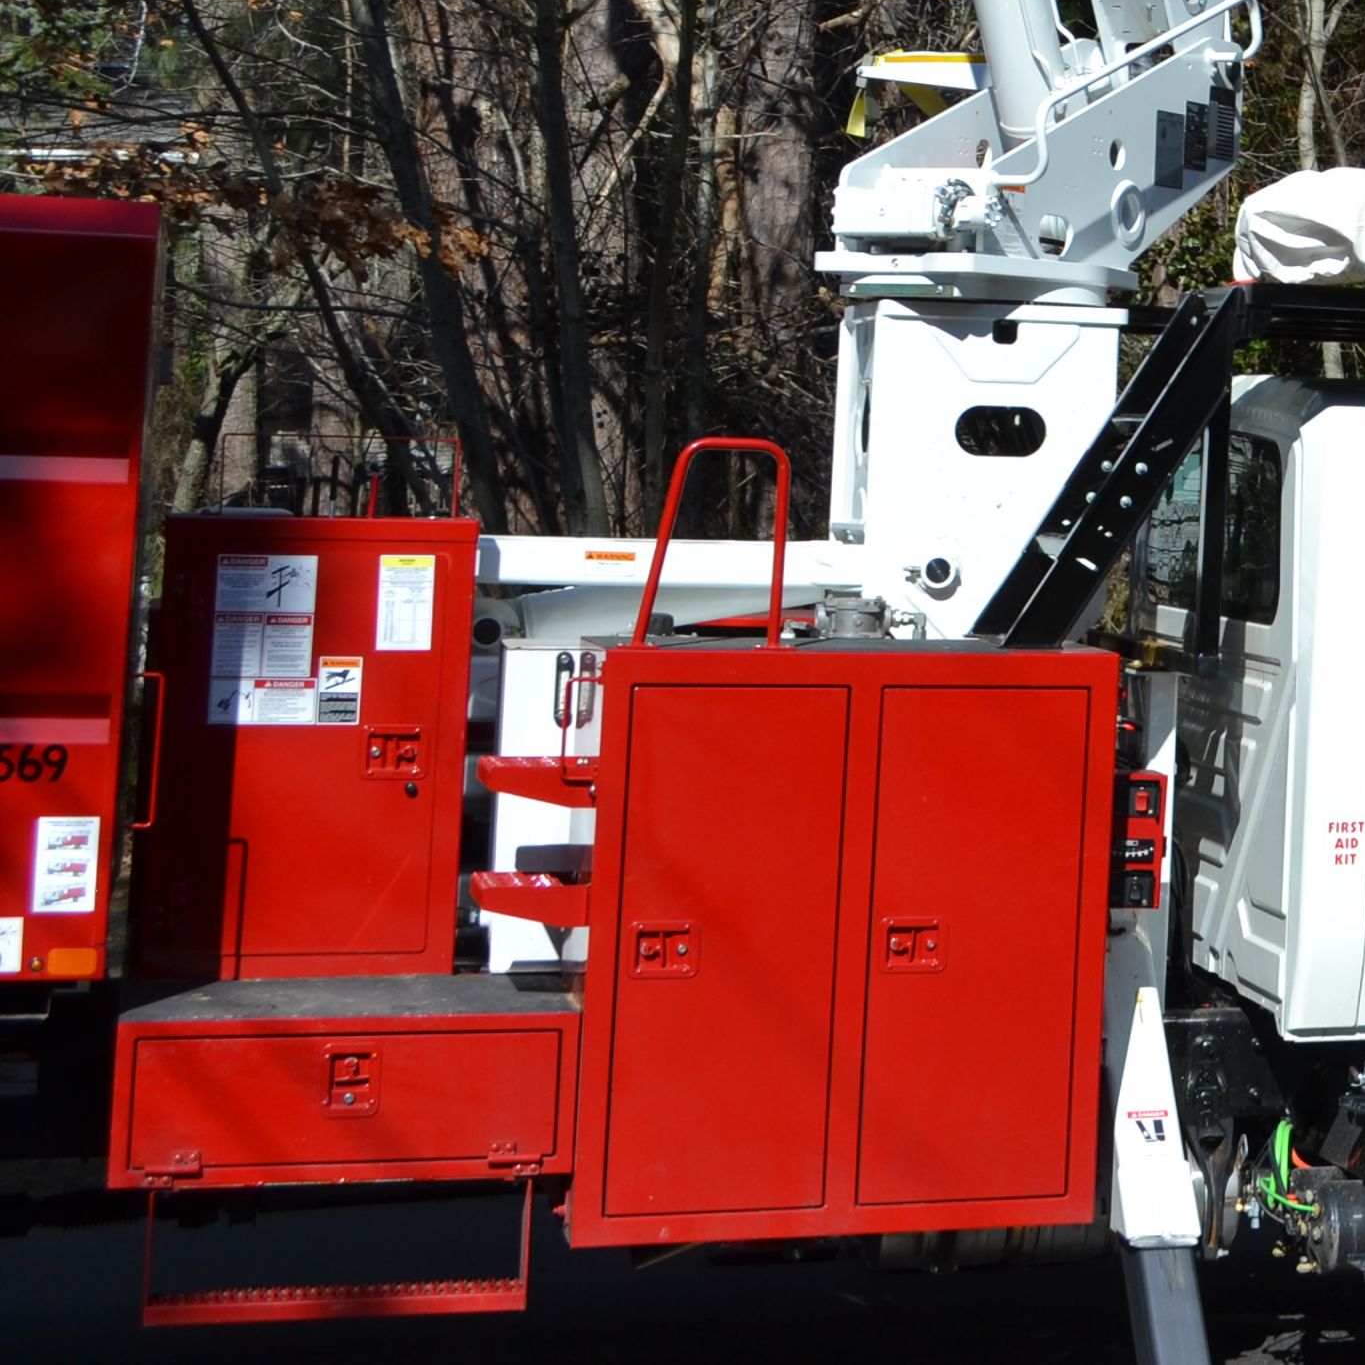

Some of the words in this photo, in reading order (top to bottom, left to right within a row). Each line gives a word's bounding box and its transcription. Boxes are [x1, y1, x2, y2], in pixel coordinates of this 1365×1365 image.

[229, 557, 266, 565] DANGER
[226, 615, 260, 623] DANGER
[277, 616, 308, 624] DANGER
[1328, 822, 1365, 833] FIRST
[1335, 838, 1359, 849] AID
[1335, 854, 1357, 865] KIT
